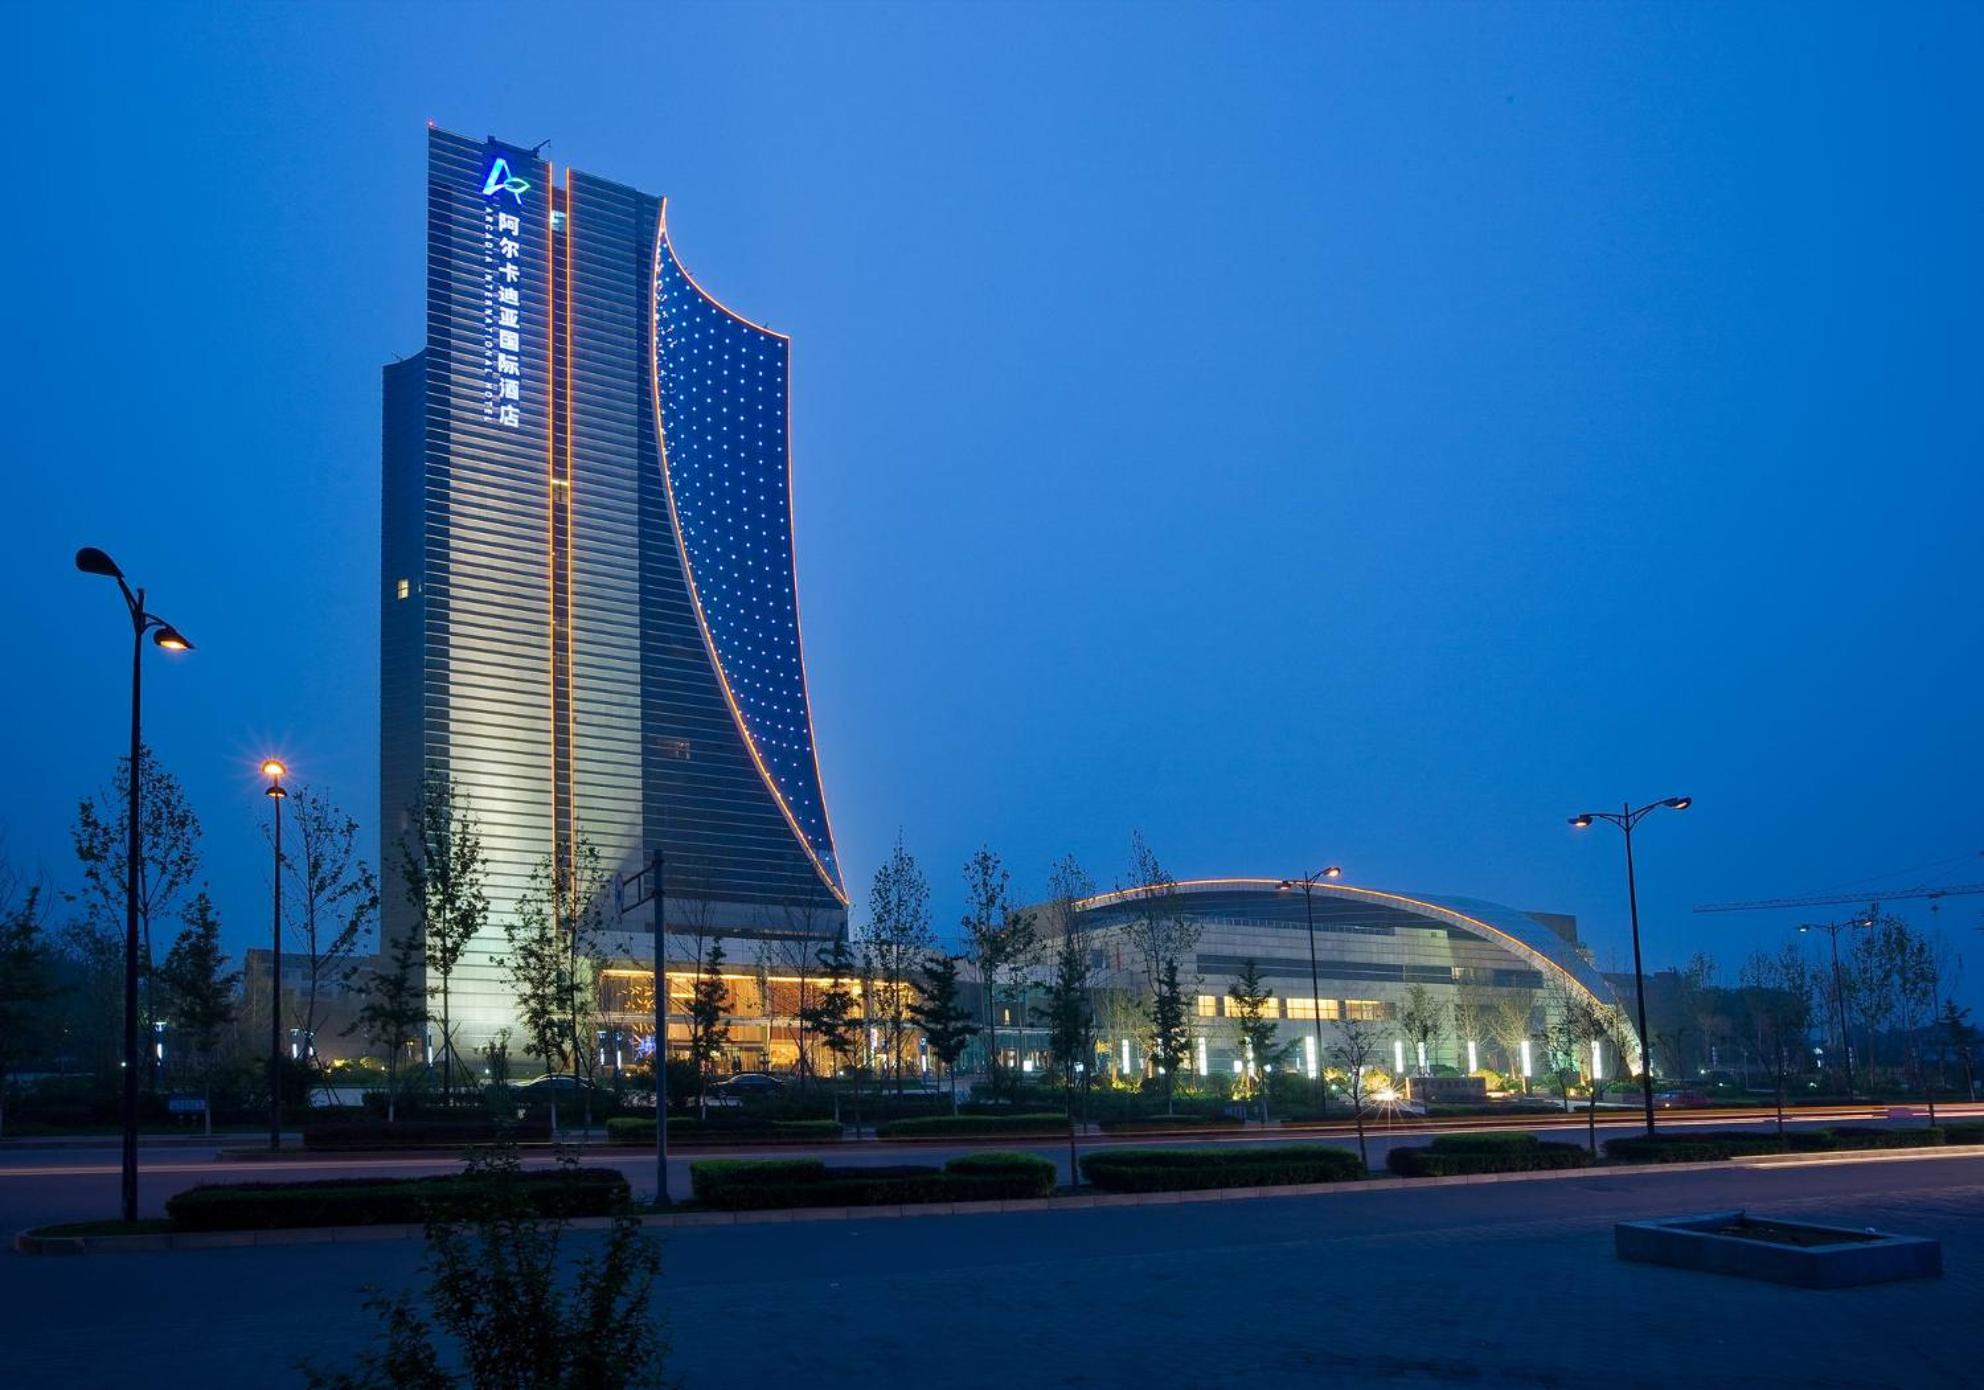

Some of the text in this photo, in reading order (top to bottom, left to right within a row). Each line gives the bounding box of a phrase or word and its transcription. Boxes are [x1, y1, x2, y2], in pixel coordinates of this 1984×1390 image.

[484, 206, 493, 421] ARCADIA INTERNATIONAL HOTEL
[498, 211, 520, 428] 阿尔卡迪亚国际酒店
